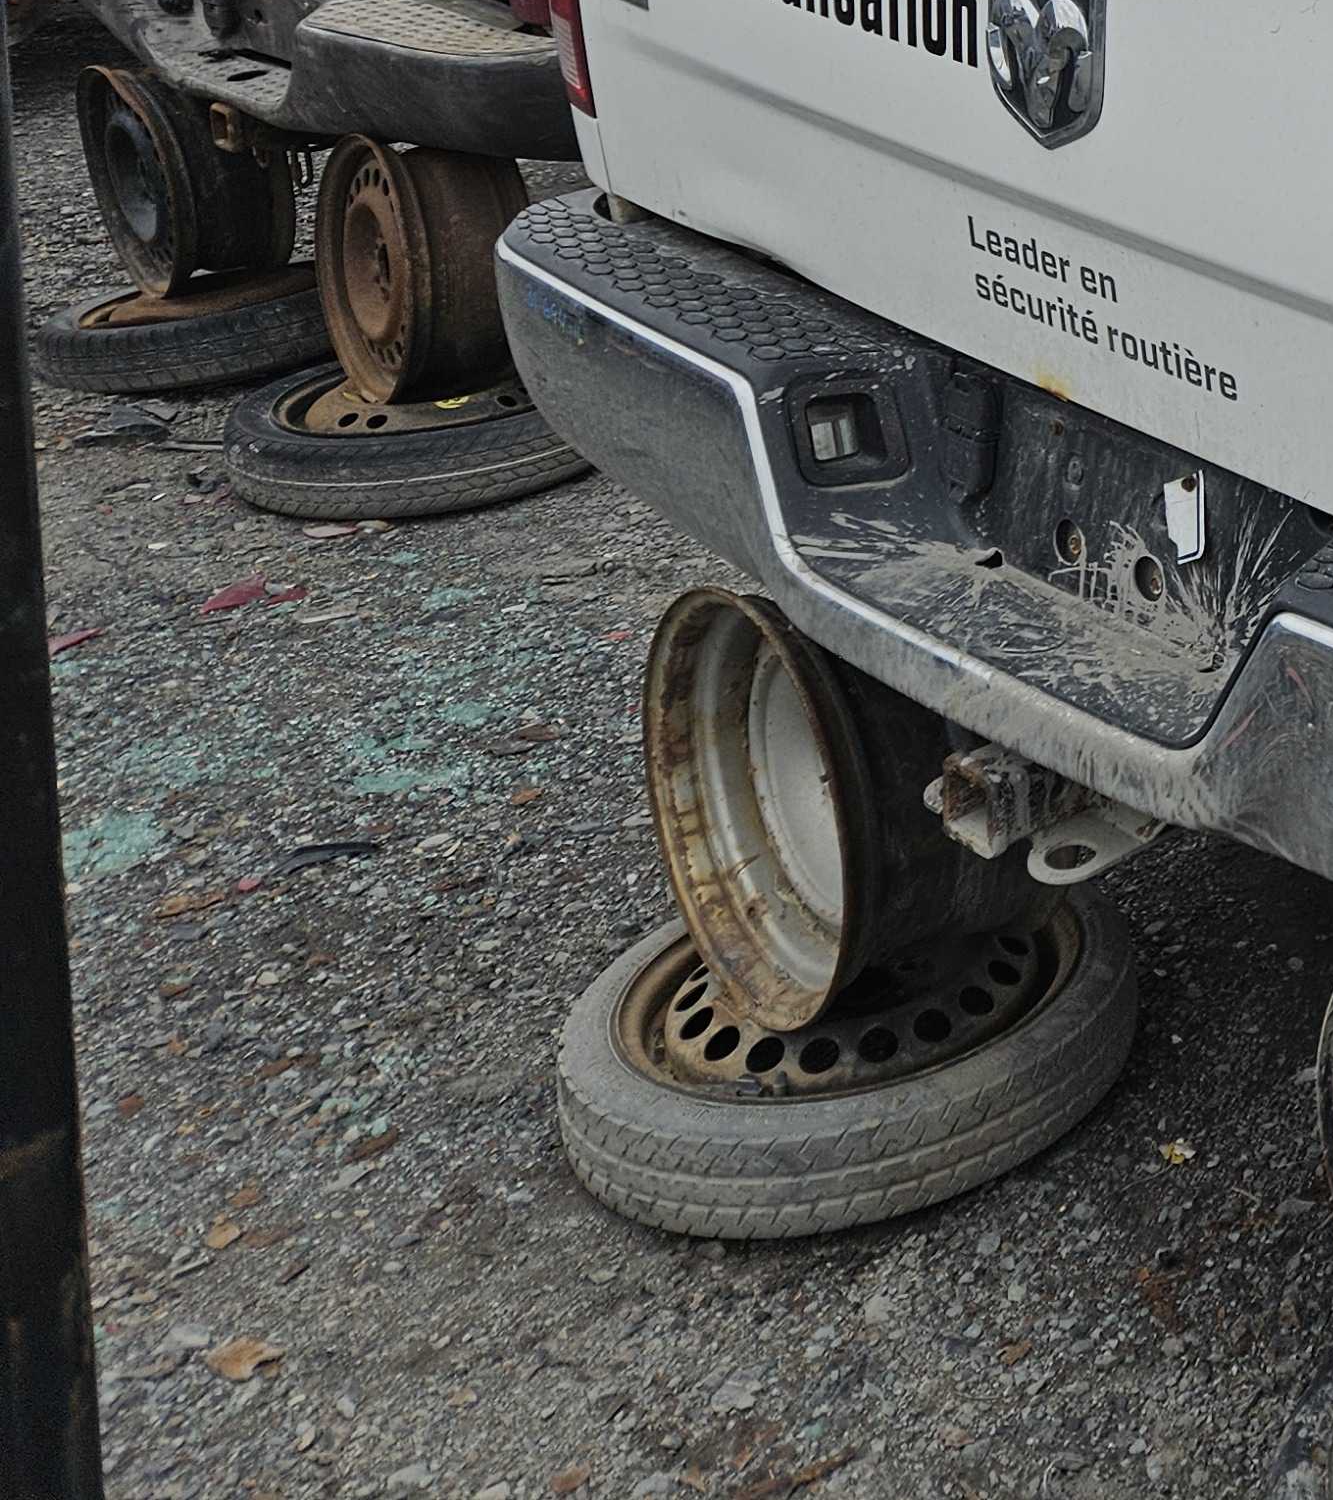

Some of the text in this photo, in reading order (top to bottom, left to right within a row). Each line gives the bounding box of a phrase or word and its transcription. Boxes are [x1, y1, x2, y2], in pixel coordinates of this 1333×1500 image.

[967, 215, 1118, 303] Leader en
[975, 273, 1238, 401] sécurité routière
